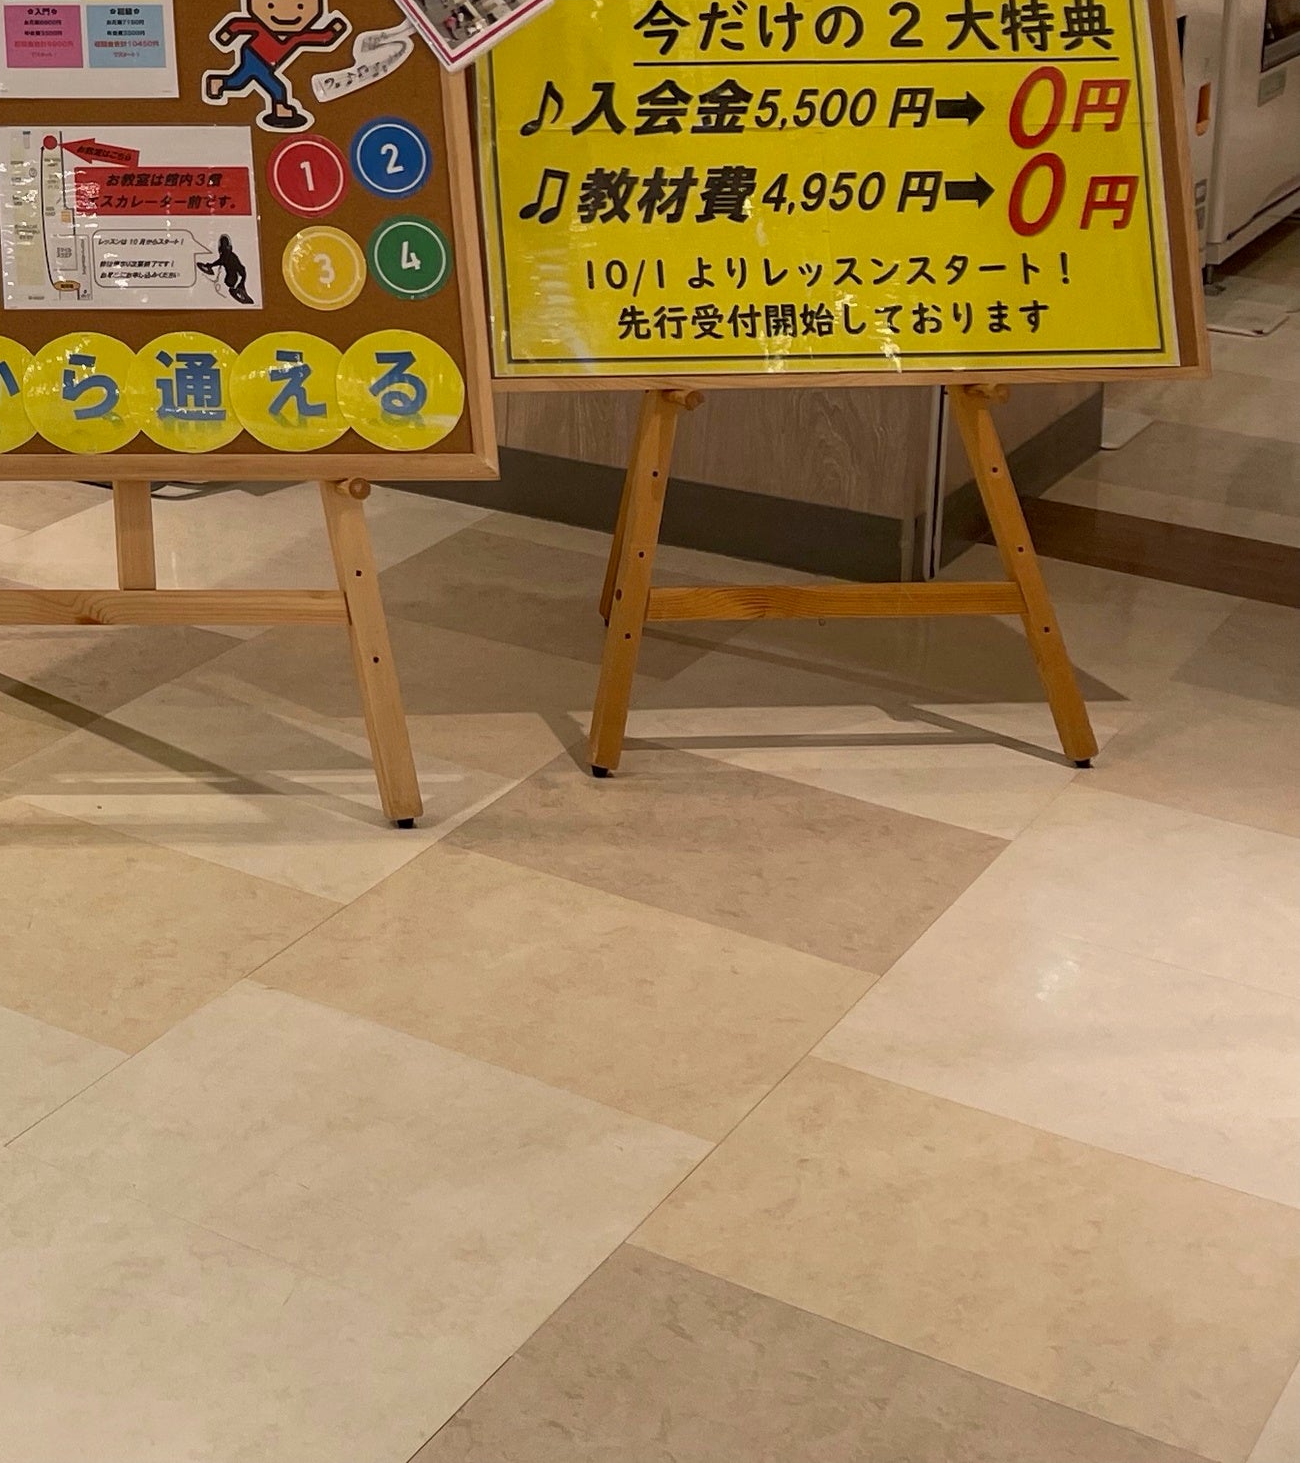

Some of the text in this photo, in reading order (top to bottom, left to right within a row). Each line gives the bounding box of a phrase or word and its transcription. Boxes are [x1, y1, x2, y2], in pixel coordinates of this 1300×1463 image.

[300, 143, 404, 192] 1 2
[313, 240, 422, 285] 3 4
[617, 298, 1051, 339] 先行受付開始しております
